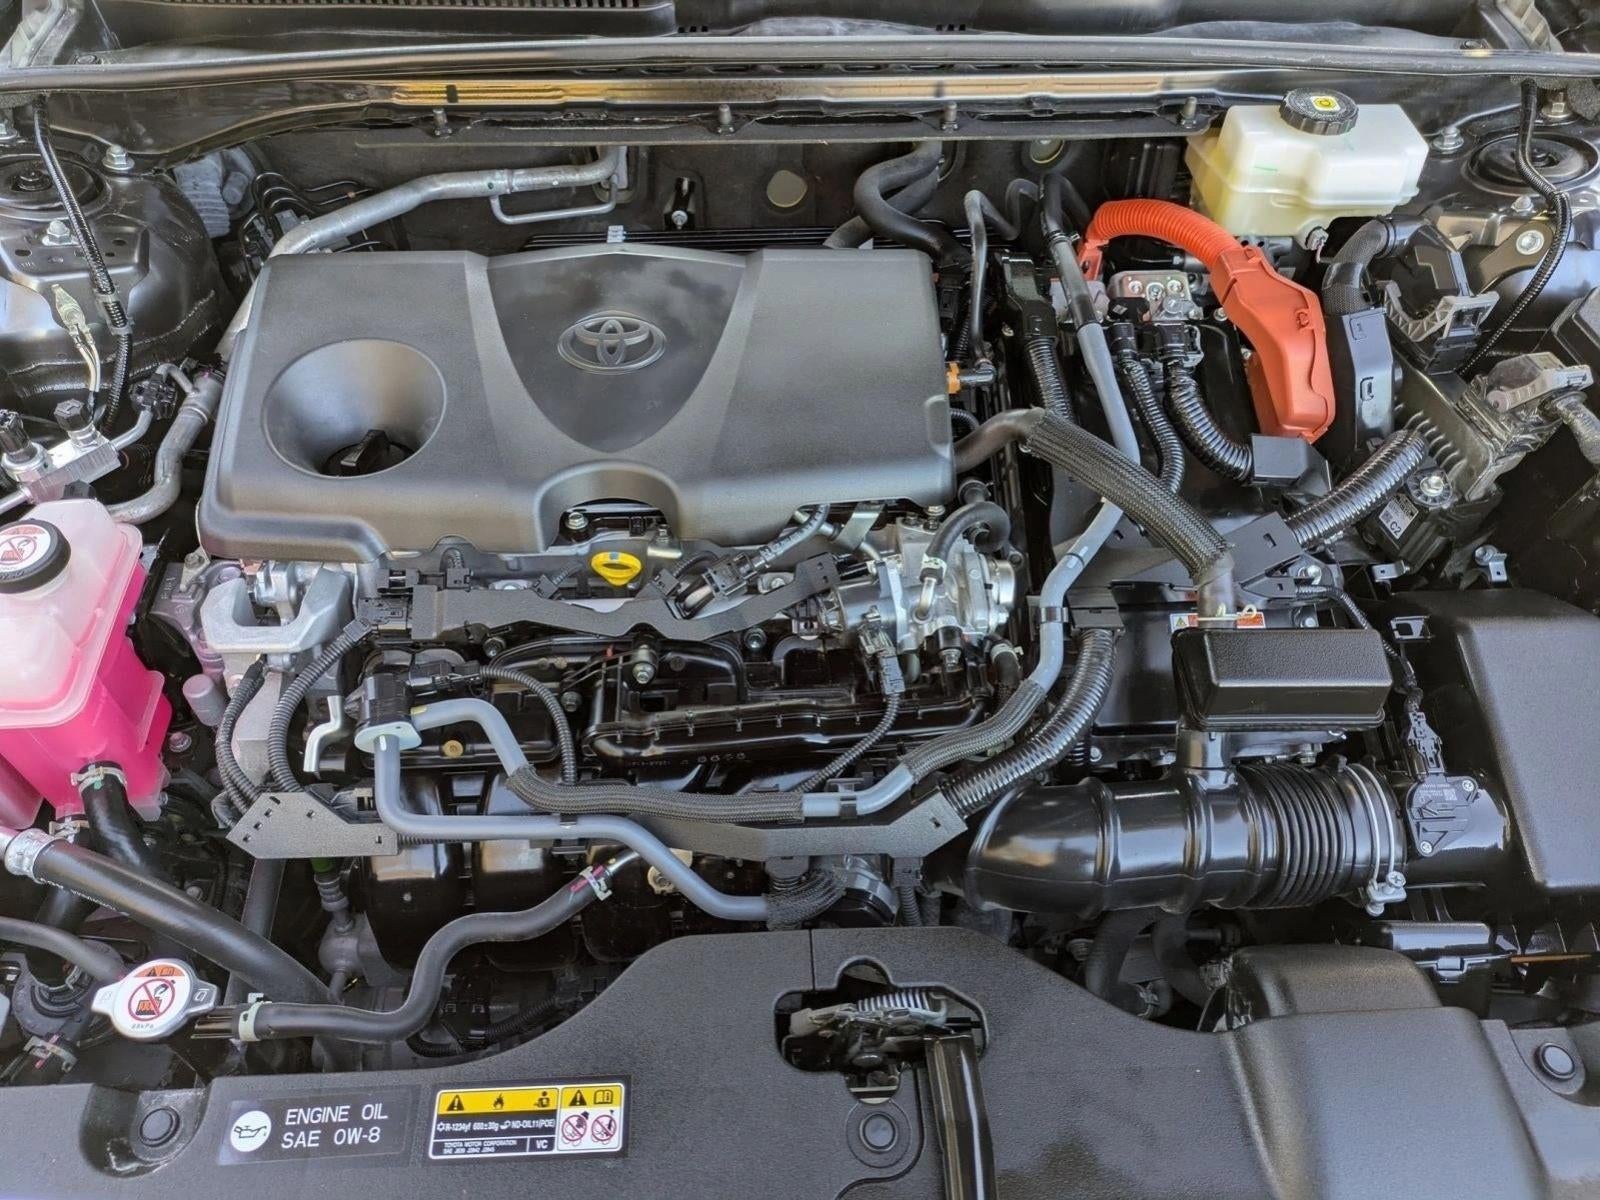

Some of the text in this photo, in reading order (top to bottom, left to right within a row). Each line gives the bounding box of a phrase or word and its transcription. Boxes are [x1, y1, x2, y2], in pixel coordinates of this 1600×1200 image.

[1390, 521, 1402, 536] C2
[285, 1103, 389, 1126] ENGINE OIL
[281, 1126, 381, 1149] SAE 0W-8
[536, 1139, 549, 1149] VC
